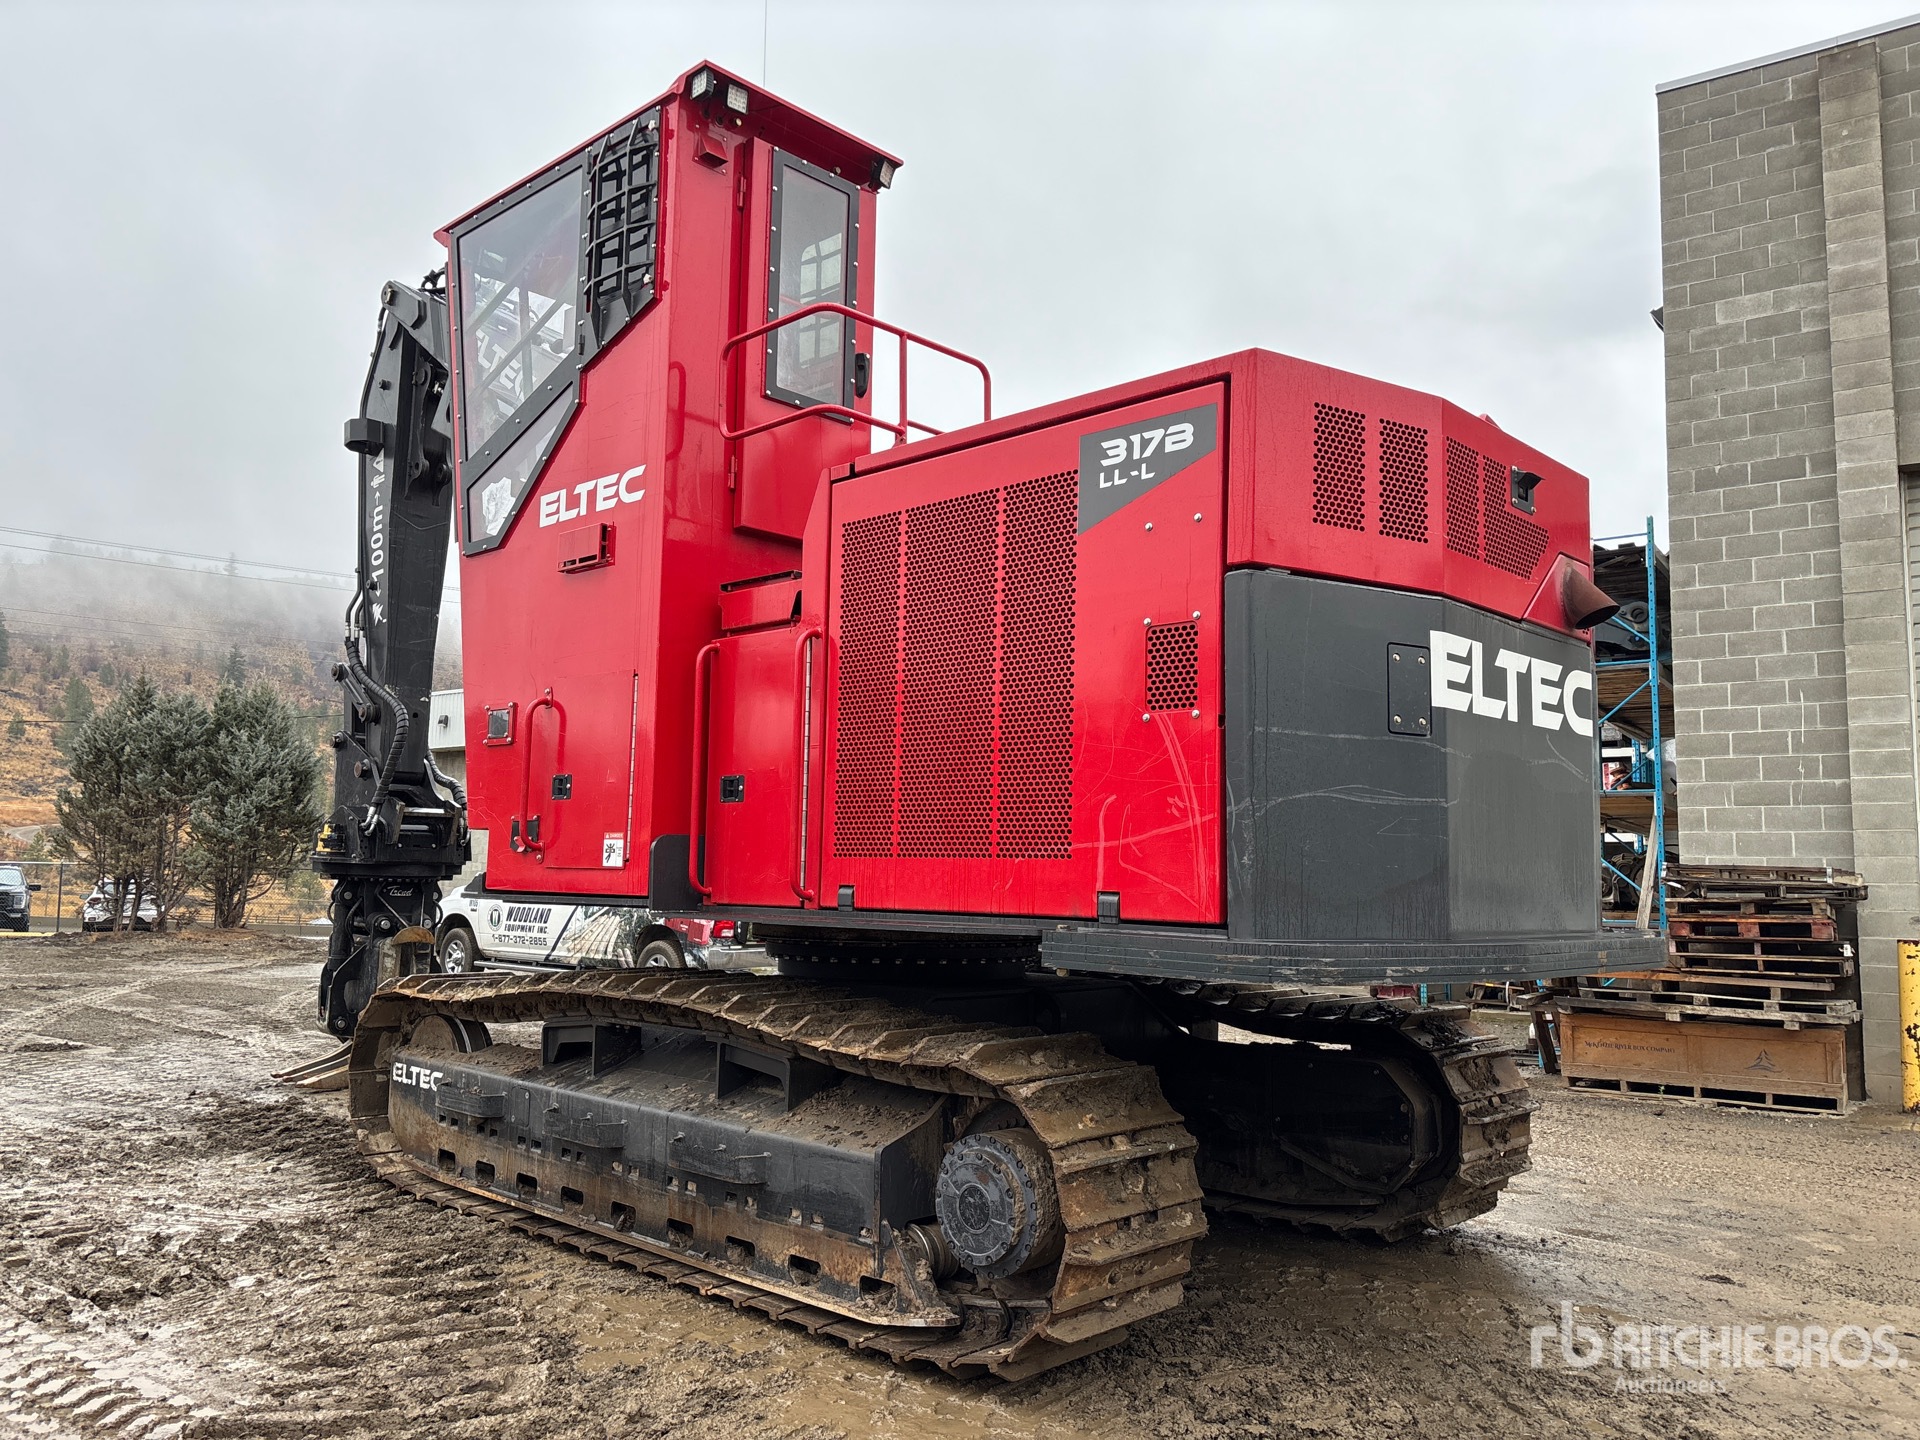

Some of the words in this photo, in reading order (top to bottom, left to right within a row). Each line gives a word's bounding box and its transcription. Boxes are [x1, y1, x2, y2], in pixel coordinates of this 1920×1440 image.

[1100, 422, 1194, 467] 317B
[1099, 462, 1156, 489] LL-L
[539, 464, 647, 528] ELTEC
[1429, 630, 1593, 737] ELTEC
[504, 923, 535, 933] EQUIPMENT
[536, 926, 549, 935] INC.
[505, 906, 552, 923] WOODLAND
[491, 934, 547, 946] 1-877-372-2855
[392, 1061, 444, 1092] ELTEC
